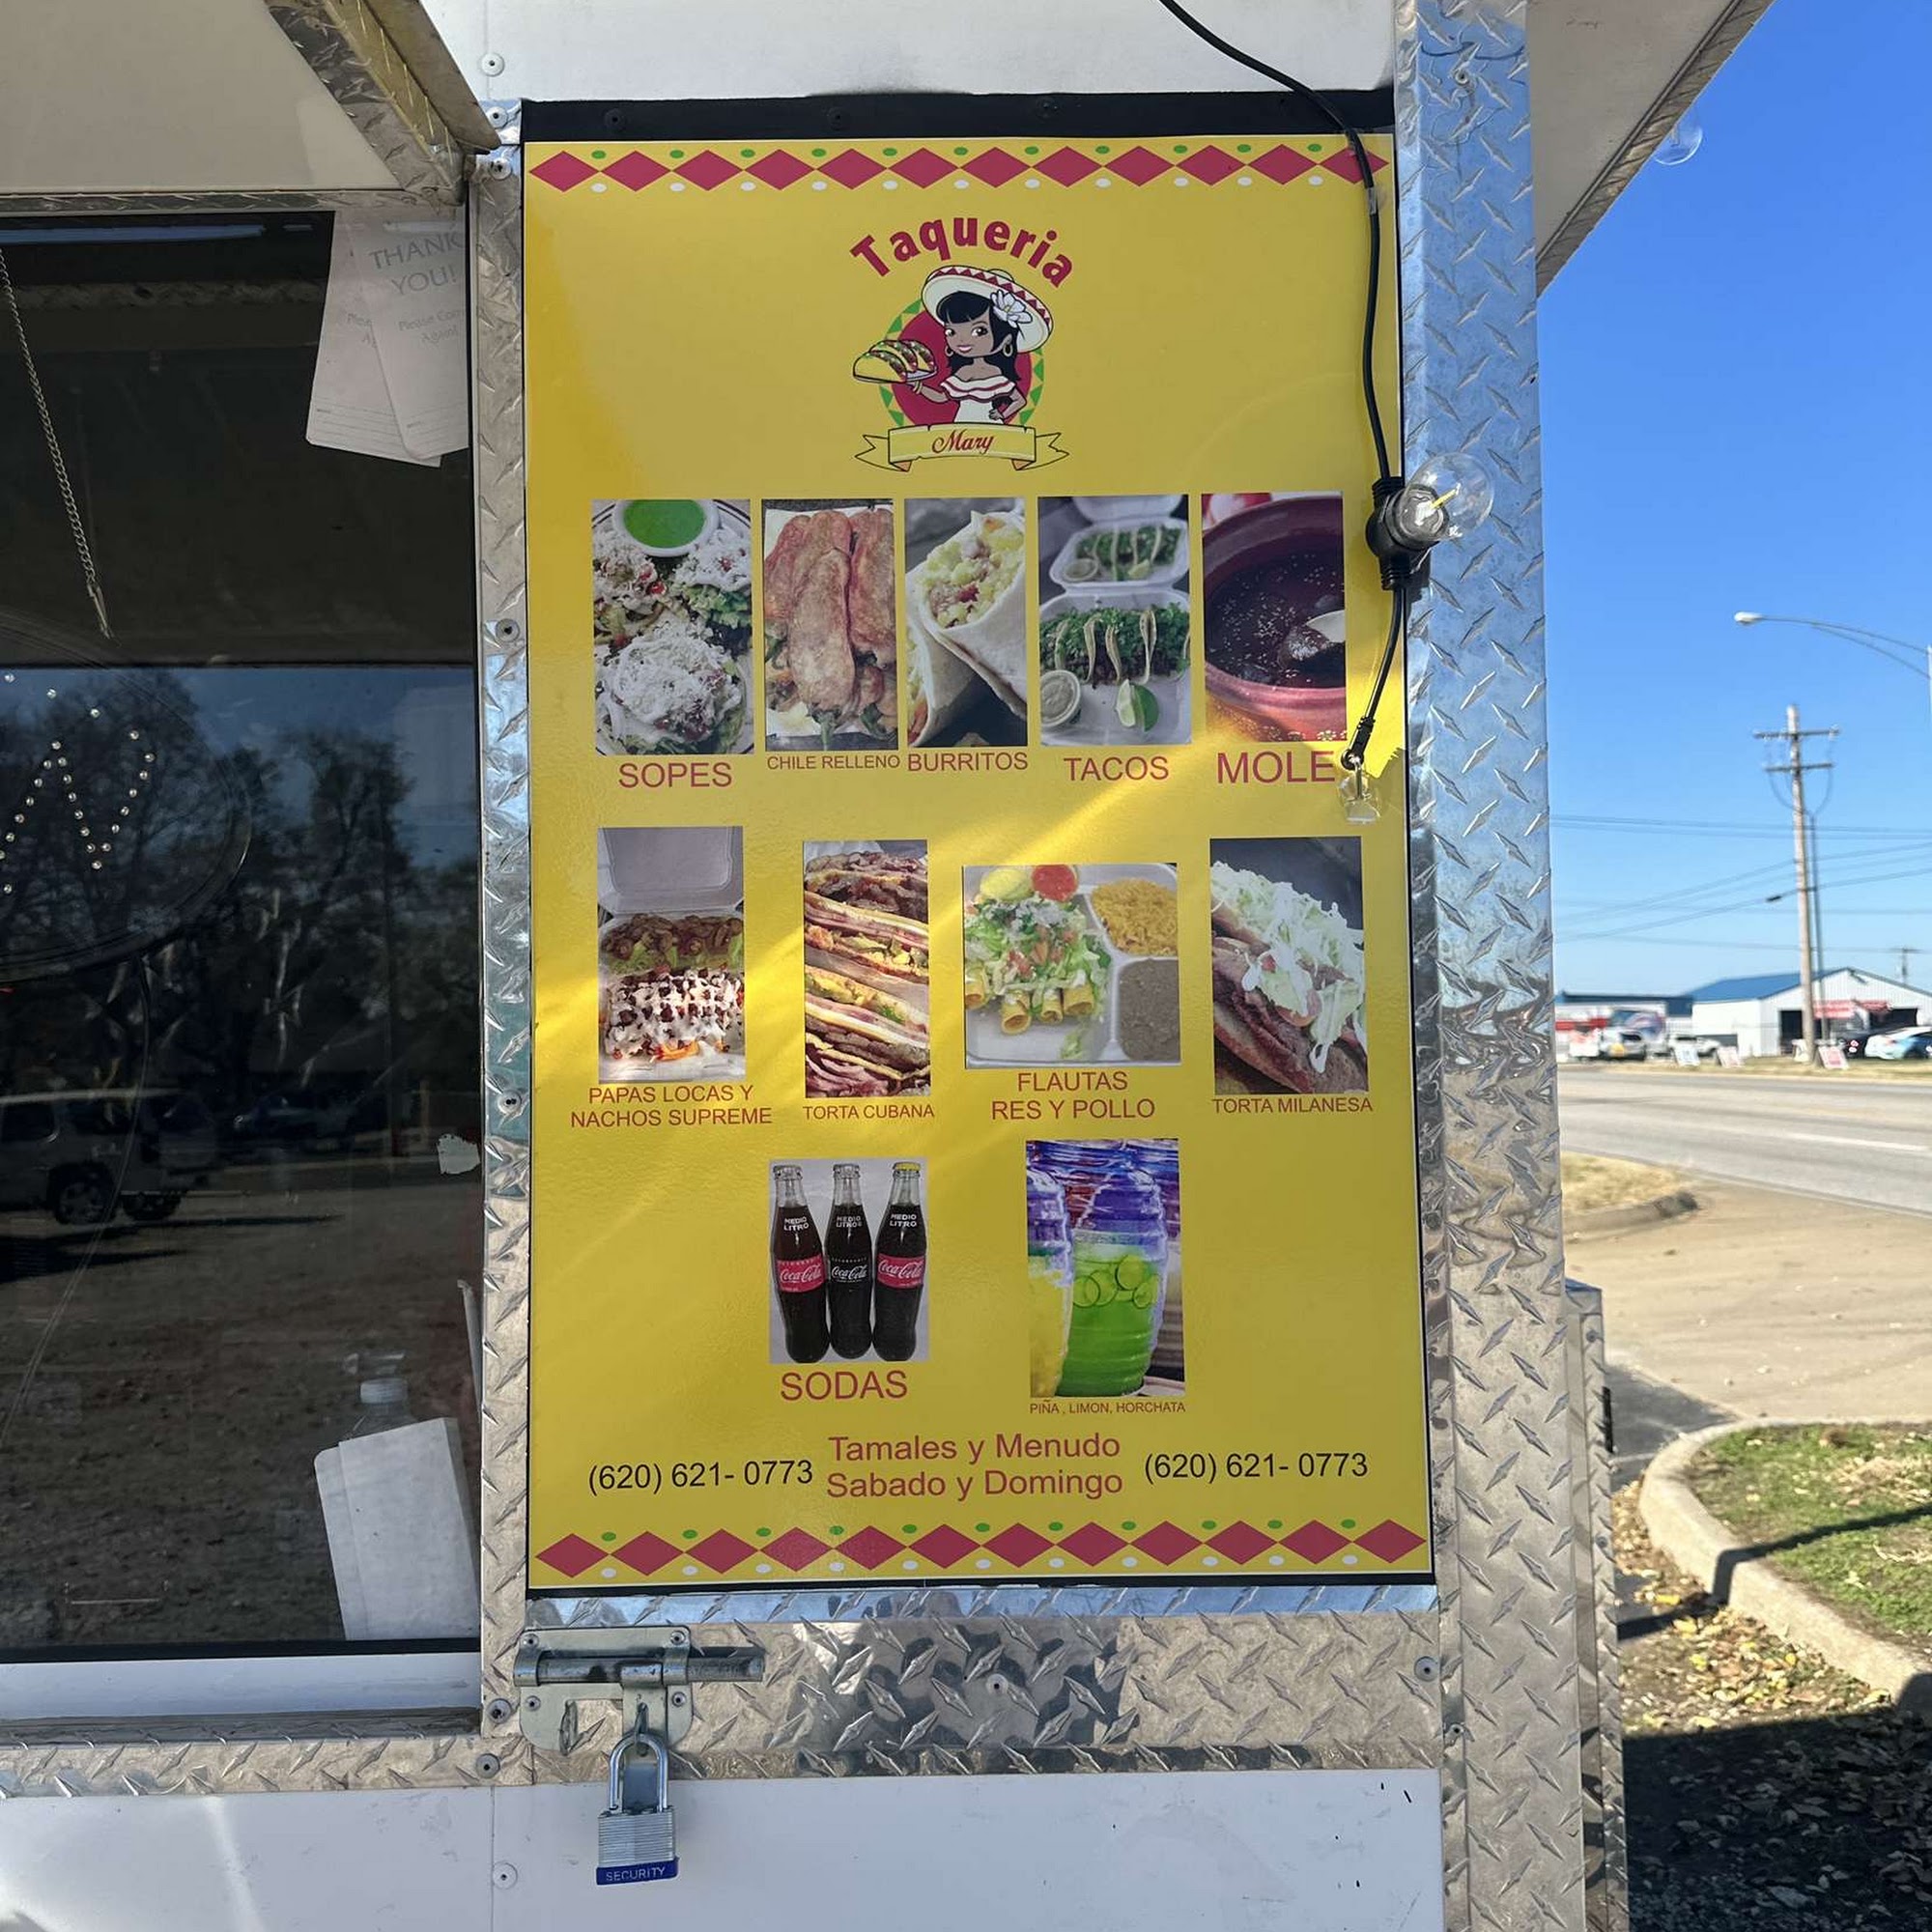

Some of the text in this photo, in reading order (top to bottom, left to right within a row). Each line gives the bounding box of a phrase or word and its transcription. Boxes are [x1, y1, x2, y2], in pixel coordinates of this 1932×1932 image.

[850, 216, 1073, 288] Taqueria
[391, 264, 458, 296] YOU!
[931, 429, 994, 454] Mary
[767, 754, 900, 770] CHILE RELLENO
[907, 752, 1028, 772] BURRITOS
[1064, 756, 1170, 781] TACOS
[1216, 751, 1336, 784] MOLE
[618, 761, 732, 788] SOPES
[1017, 1071, 1128, 1093] FLAUTAS
[588, 1085, 754, 1104] PAPAS LOCAS Y
[802, 1104, 935, 1121] TORTA CUBANA
[991, 1098, 1155, 1121] RES Y POLLO
[1212, 1097, 1374, 1114] TORTA MILANESA
[570, 1107, 773, 1128] NACHOS SUPREME
[783, 1216, 809, 1226] MEDIO
[889, 1220, 918, 1229] LITRO
[890, 1212, 918, 1221] MEDIO
[783, 1222, 810, 1233] LITRO
[780, 1263, 824, 1284] Coca-Cola
[831, 1264, 868, 1280] Coca-Cola
[877, 1259, 924, 1279] Coca-Cola
[781, 1369, 908, 1402] SODAS
[1069, 1403, 1113, 1414] LIMON,
[1117, 1401, 1186, 1413] HORCHATA
[828, 1433, 1121, 1464] Tamales y Menudo
[588, 1460, 813, 1496] (620) 621- 0773
[1144, 1451, 1369, 1485] (620) 621- 0773
[826, 1469, 1122, 1502] Sabado y Domingo
[606, 1866, 666, 1882] SECURITY
